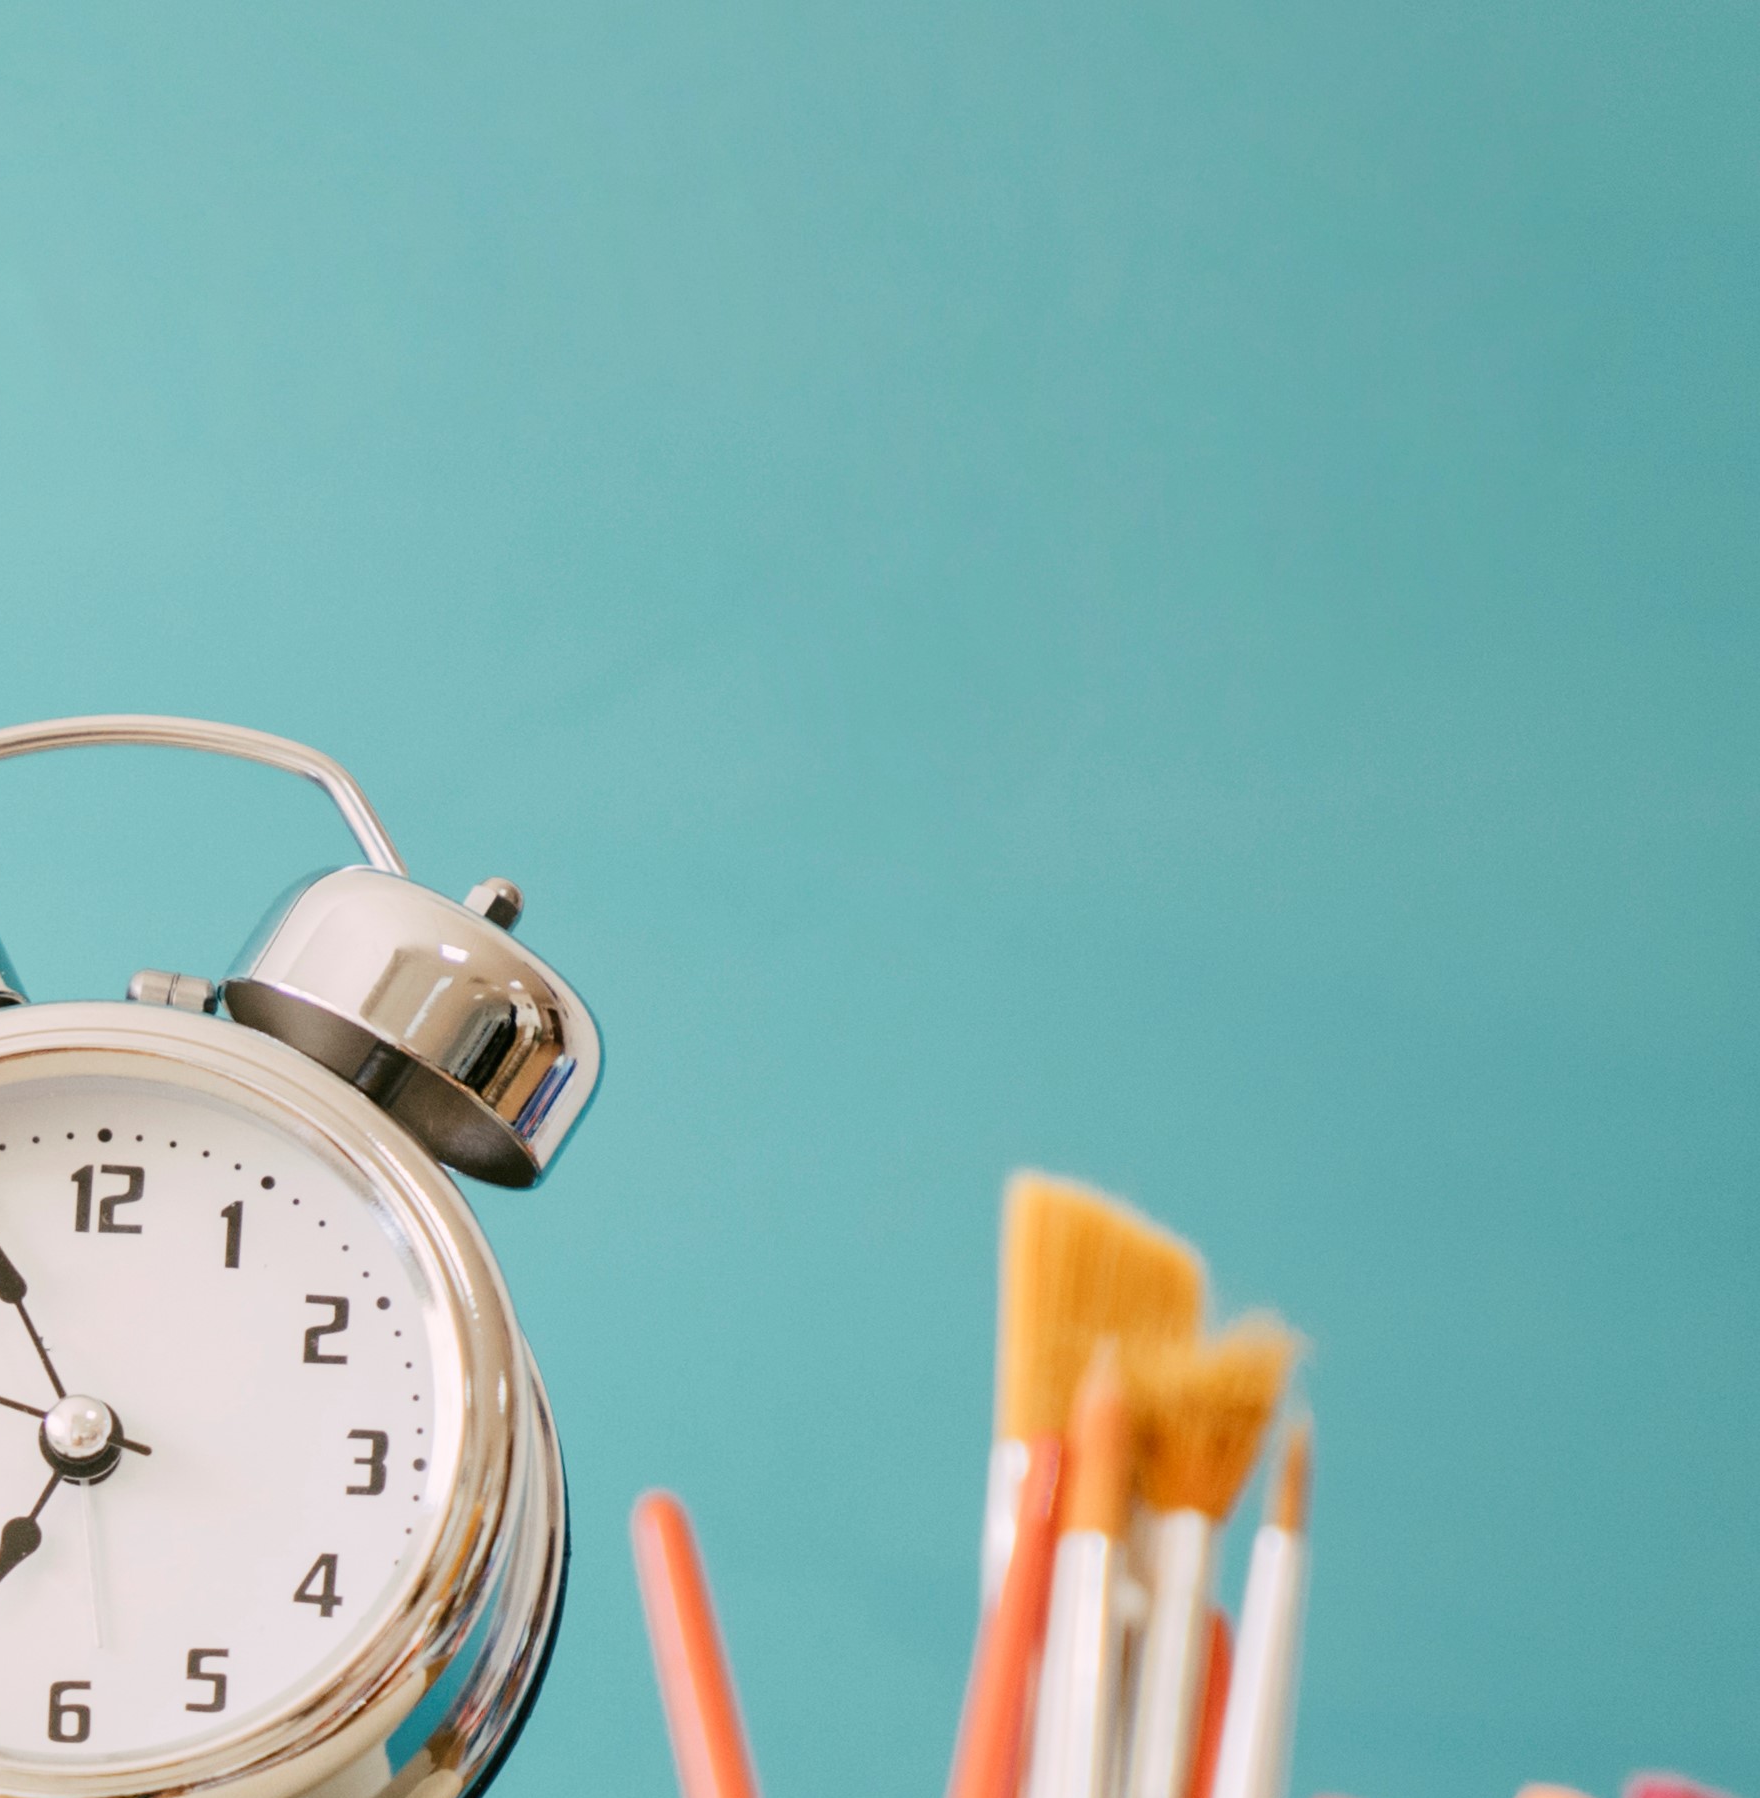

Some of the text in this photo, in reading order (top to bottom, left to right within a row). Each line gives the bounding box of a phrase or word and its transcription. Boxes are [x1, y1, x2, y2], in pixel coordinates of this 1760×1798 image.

[70, 1164, 145, 1234] 12
[220, 1200, 243, 1269] 1
[303, 1294, 350, 1365] 2
[346, 1429, 389, 1496] 3
[294, 1553, 343, 1618] 4
[48, 1681, 92, 1743] 6
[186, 1648, 229, 1713] 5
